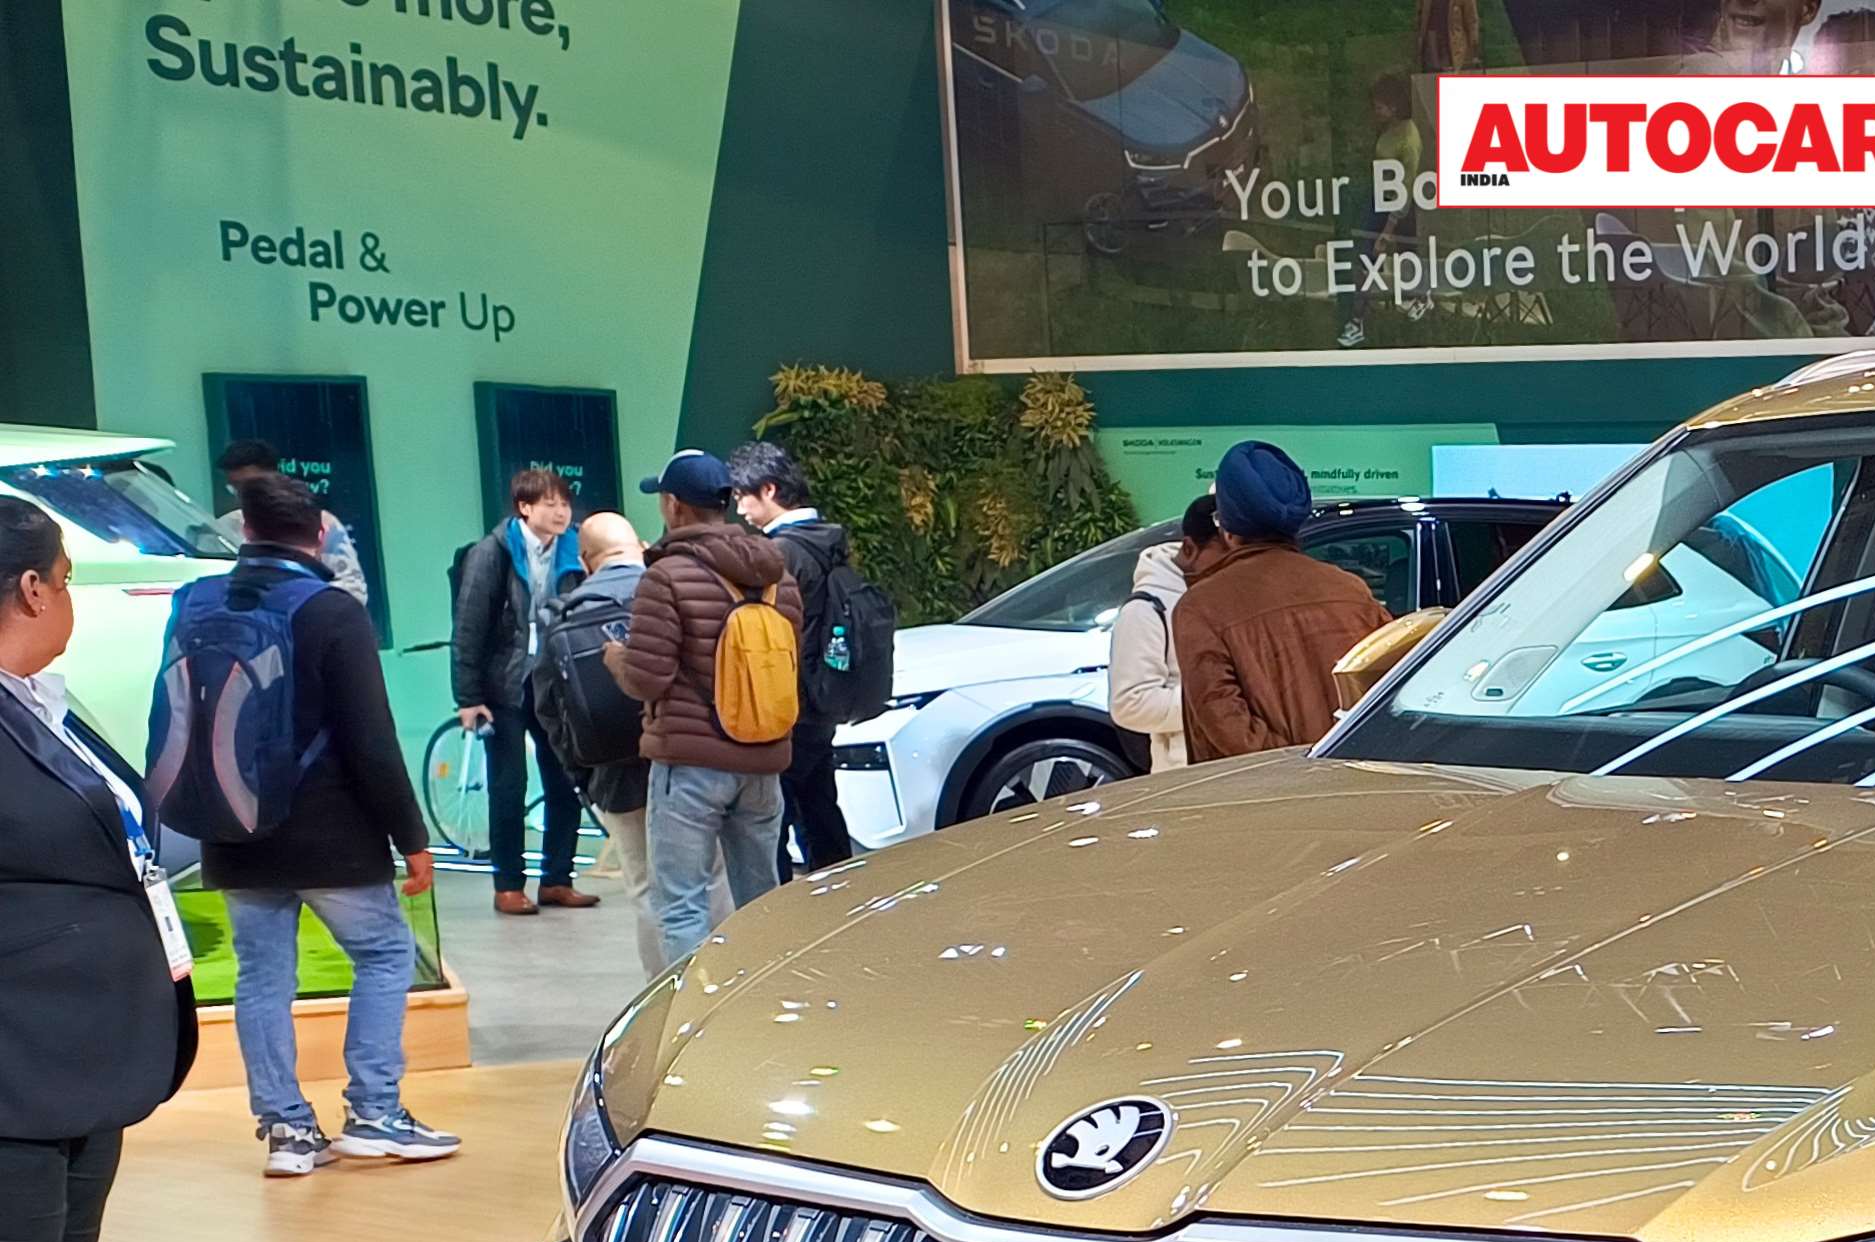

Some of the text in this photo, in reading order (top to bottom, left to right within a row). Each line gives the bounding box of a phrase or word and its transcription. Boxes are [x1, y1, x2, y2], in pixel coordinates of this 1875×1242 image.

[145, 14, 548, 141] Sustainably.
[1225, 158, 1437, 221] Your Bo
[220, 219, 391, 274] Pedal &
[1247, 213, 1867, 305] to Explore the World
[309, 281, 516, 343] Power Up
[300, 460, 331, 477] you
[556, 465, 584, 477] you
[1363, 468, 1399, 479] driven
